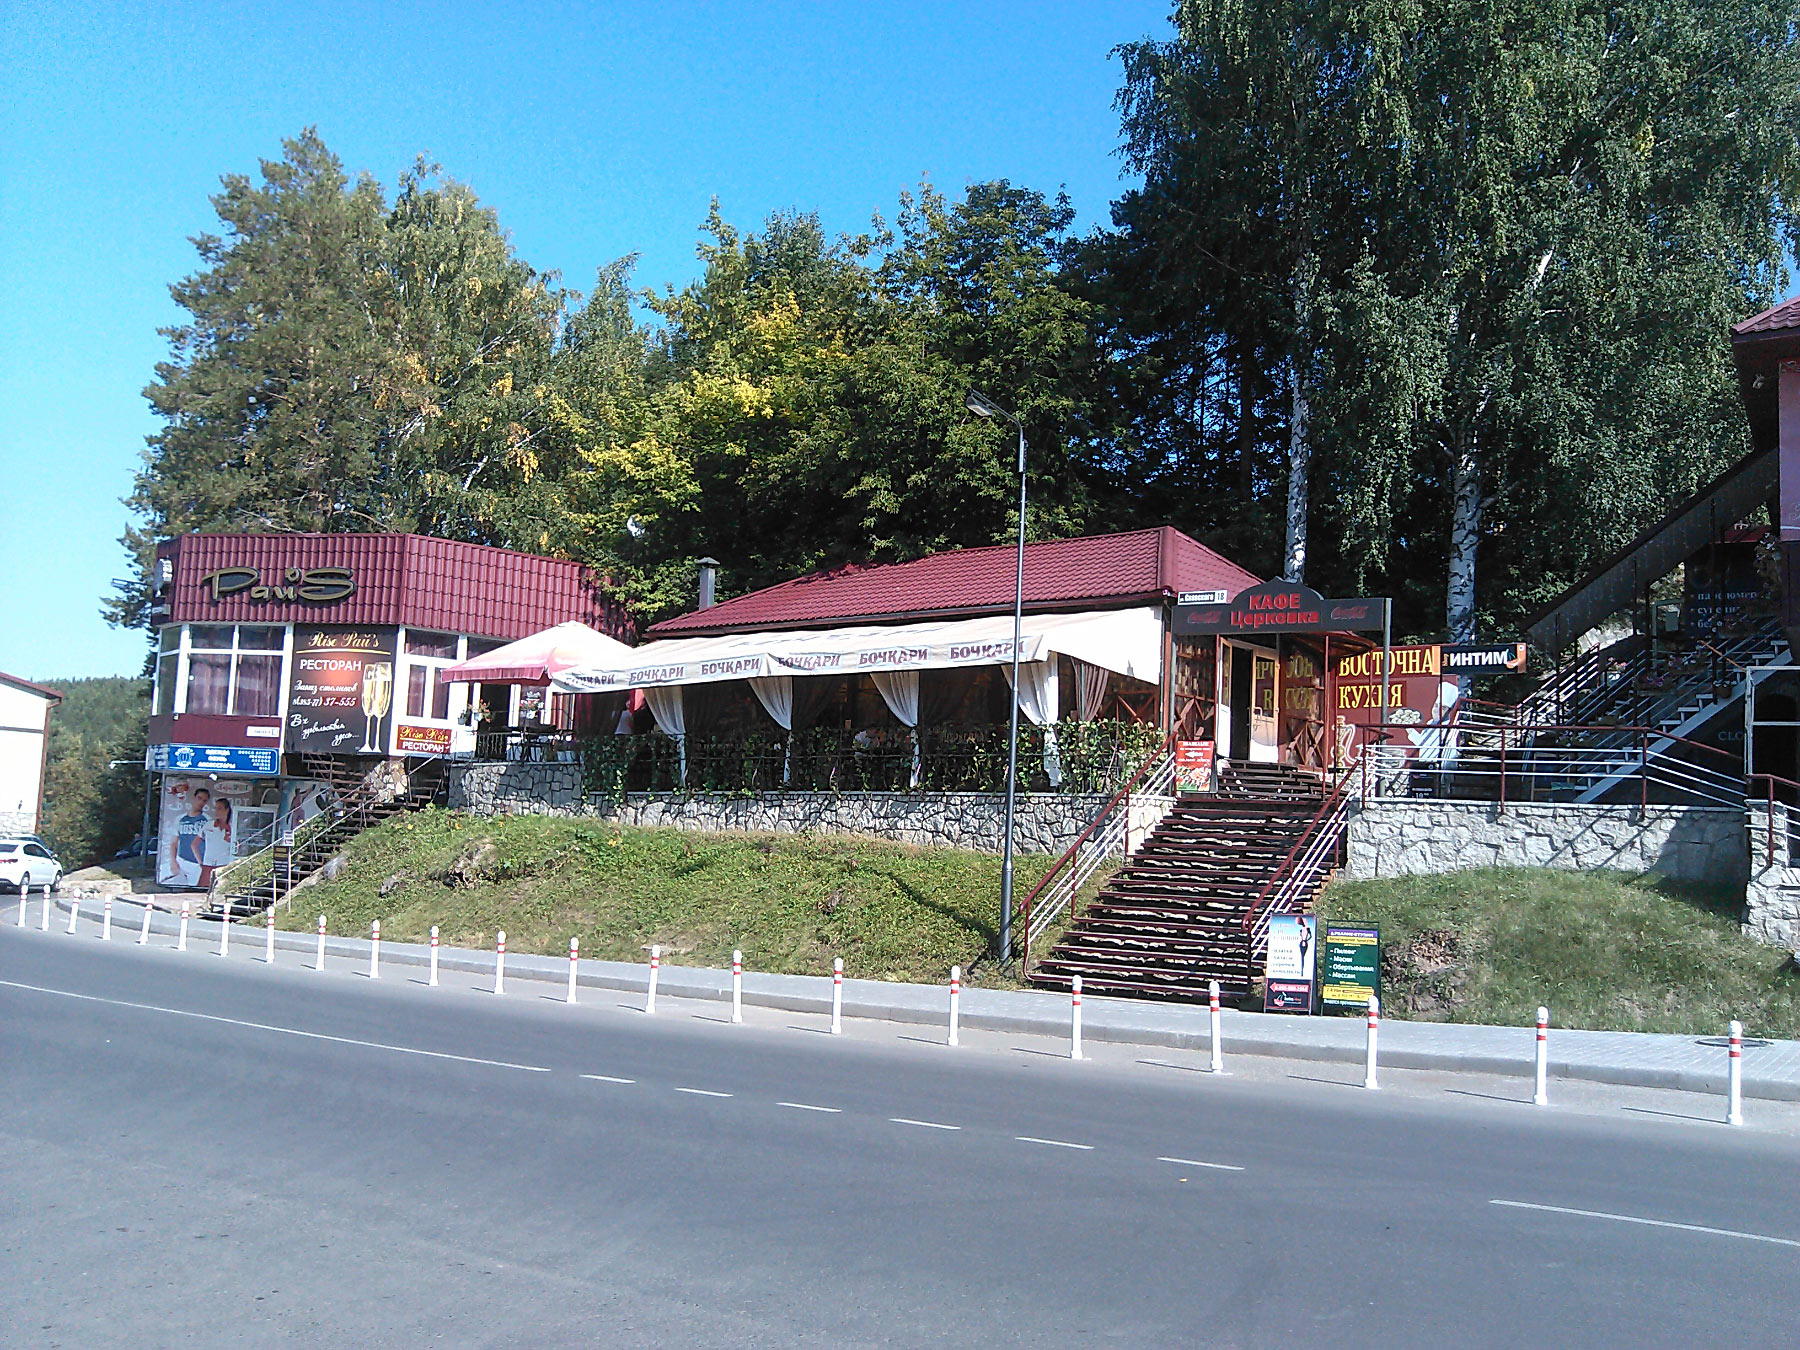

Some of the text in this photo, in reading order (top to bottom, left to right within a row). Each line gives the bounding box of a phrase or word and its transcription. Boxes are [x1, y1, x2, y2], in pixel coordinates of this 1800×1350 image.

[1217, 592, 1225, 600] 18
[1250, 593, 1300, 610] КАФЕ
[1231, 610, 1319, 629] Церковка
[859, 648, 928, 665] БОЧКАРИ
[1338, 649, 1433, 677] ВОСТОЧНА
[1449, 651, 1508, 667] ИНТИМ
[300, 659, 362, 671] РЕСТОРАН
[701, 657, 760, 675] БОЧКАРИ
[630, 666, 684, 682] БОЧКАРИ
[323, 697, 357, 707] 37-555
[402, 741, 444, 752] РЕСТОРАН
